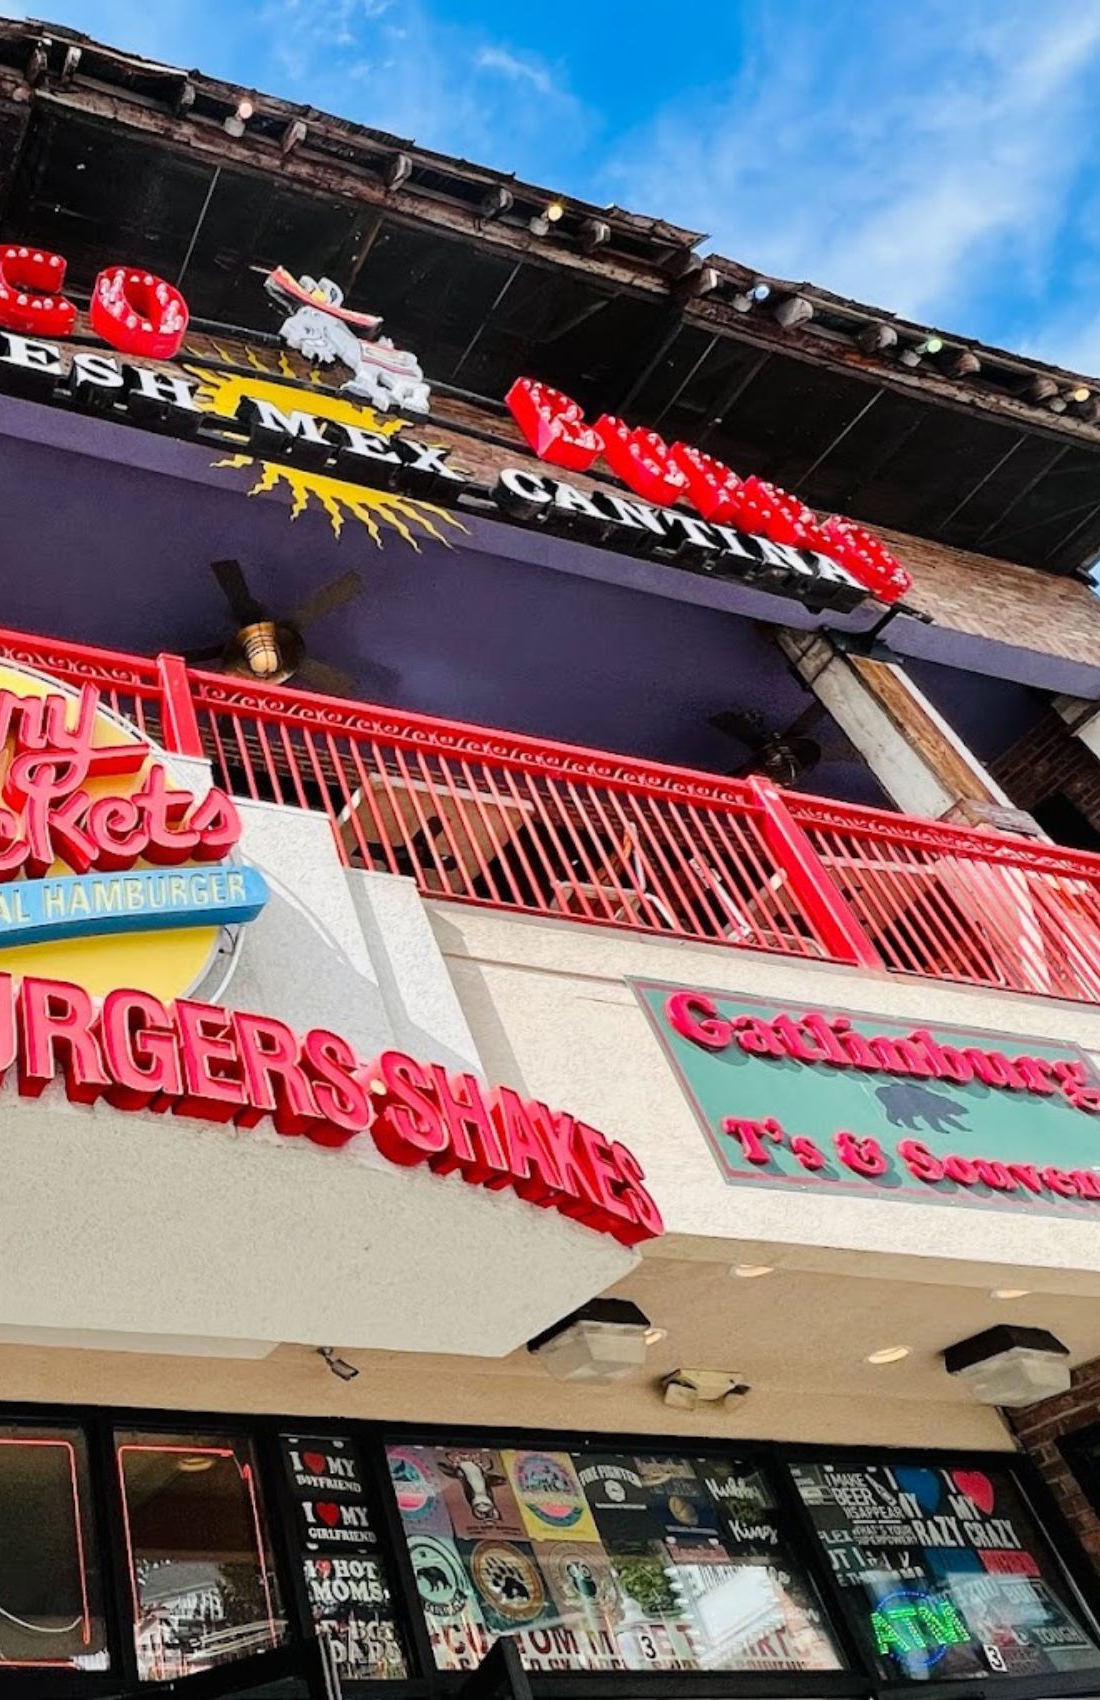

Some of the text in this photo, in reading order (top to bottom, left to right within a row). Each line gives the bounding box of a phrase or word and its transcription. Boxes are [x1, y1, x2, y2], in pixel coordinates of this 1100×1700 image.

[254, 396, 466, 482] MEX
[500, 469, 872, 592] CANTINA
[42, 868, 248, 918] HAMBURGER
[664, 991, 1100, 1114] Gatlinburg
[370, 1050, 665, 1248] SHAKES
[722, 1117, 826, 1170] T's
[834, 1131, 888, 1176] &
[290, 1451, 356, 1478] I MY
[831, 1473, 868, 1488] MAKE
[832, 1487, 878, 1506] BEER
[302, 1501, 370, 1527] I MY
[728, 1519, 779, 1545] King
[911, 1516, 966, 1547] RAZY
[963, 1519, 1023, 1549] CRAZY
[333, 1560, 379, 1579] HOT
[310, 1579, 384, 1602] MOMS
[870, 1600, 971, 1655] ATM
[640, 1635, 657, 1659] 3
